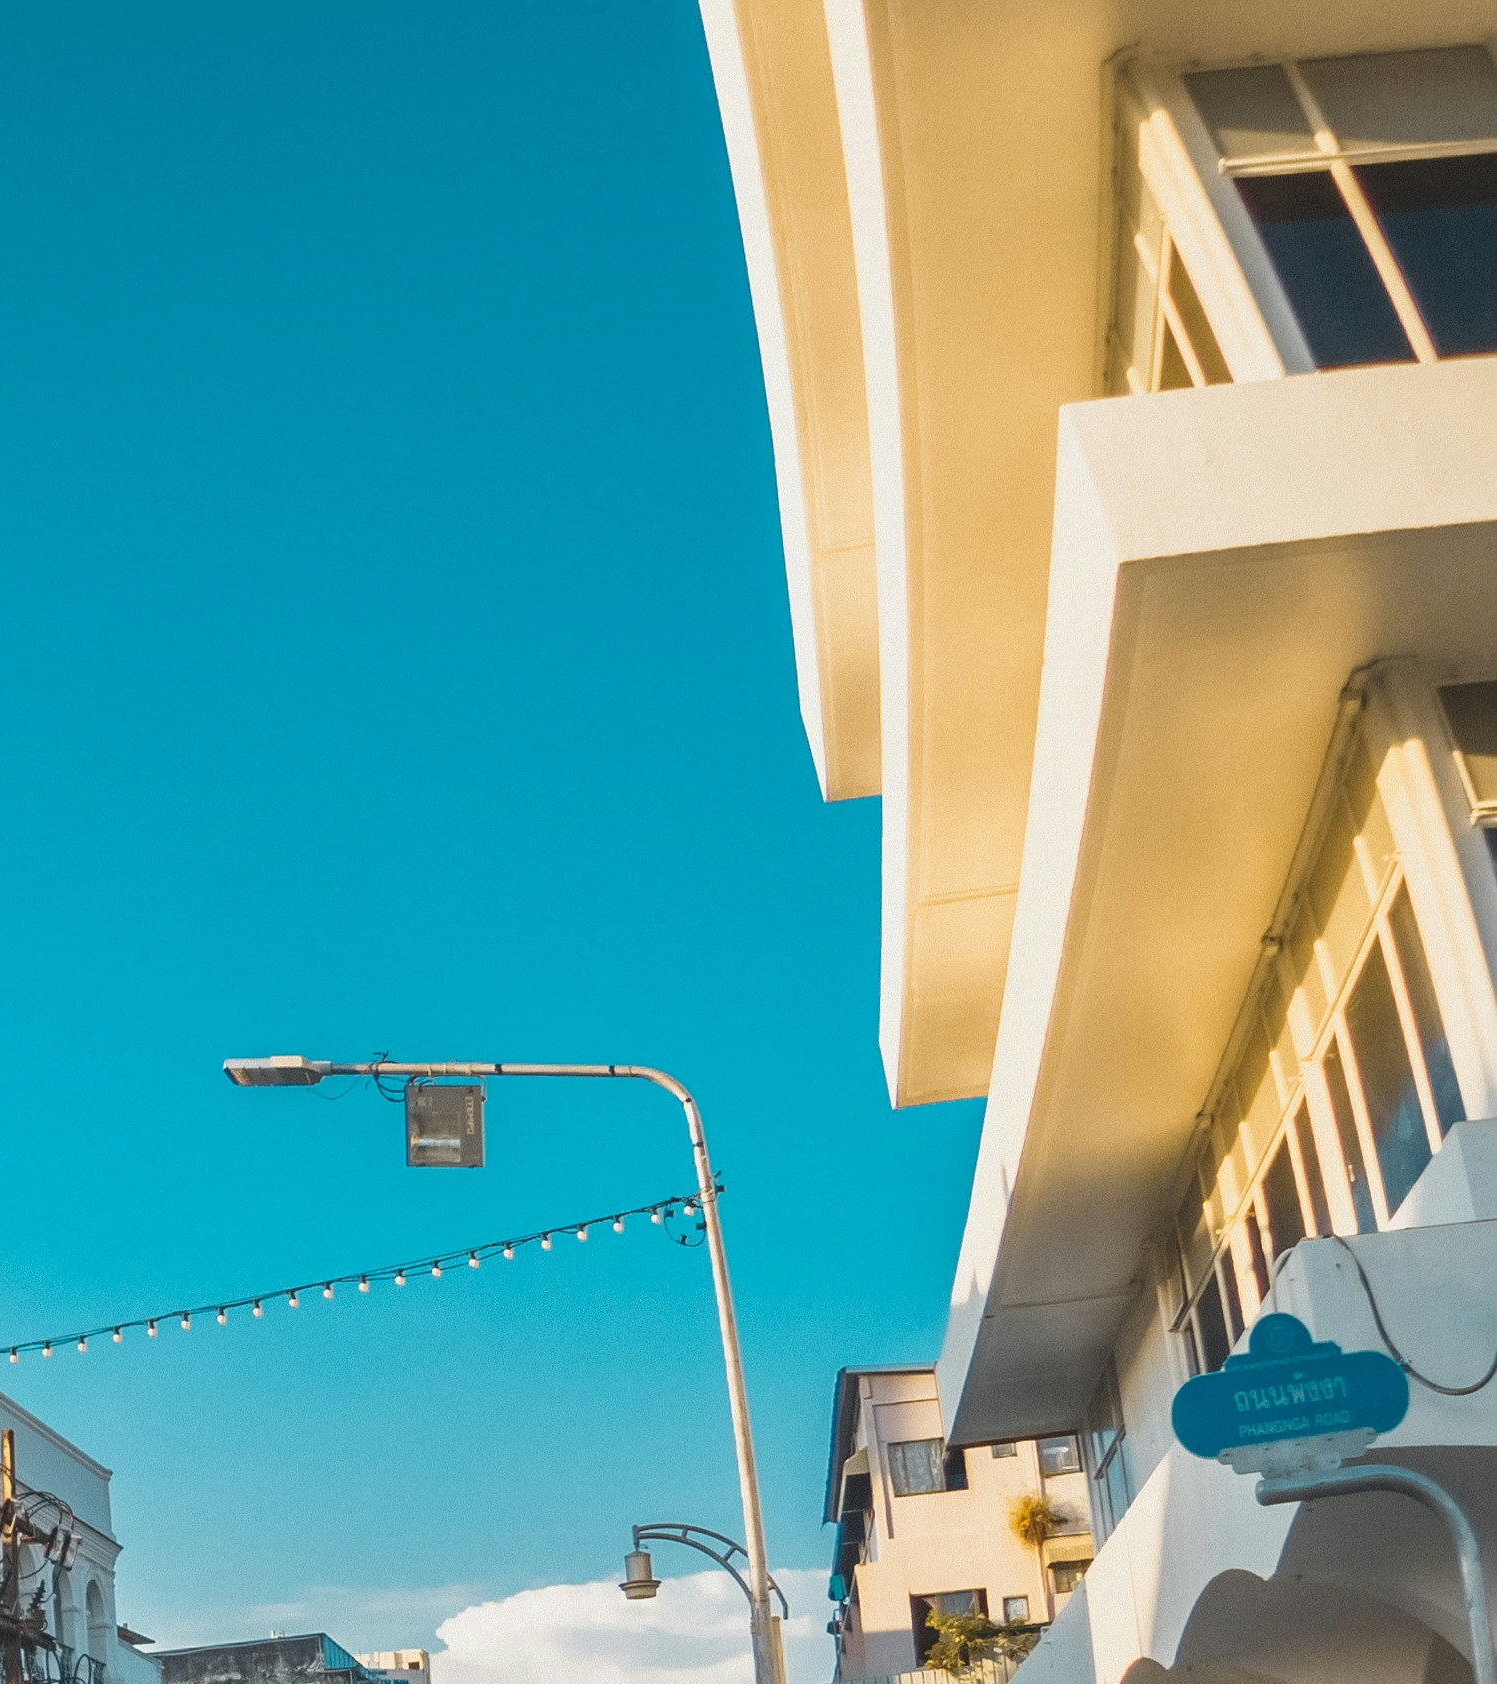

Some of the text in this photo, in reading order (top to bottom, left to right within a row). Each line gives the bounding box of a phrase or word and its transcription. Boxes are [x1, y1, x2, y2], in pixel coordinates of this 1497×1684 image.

[1233, 1372, 1347, 1413] ถนนพังงา
[1238, 1410, 1351, 1439] PHANGNGA ROAD
